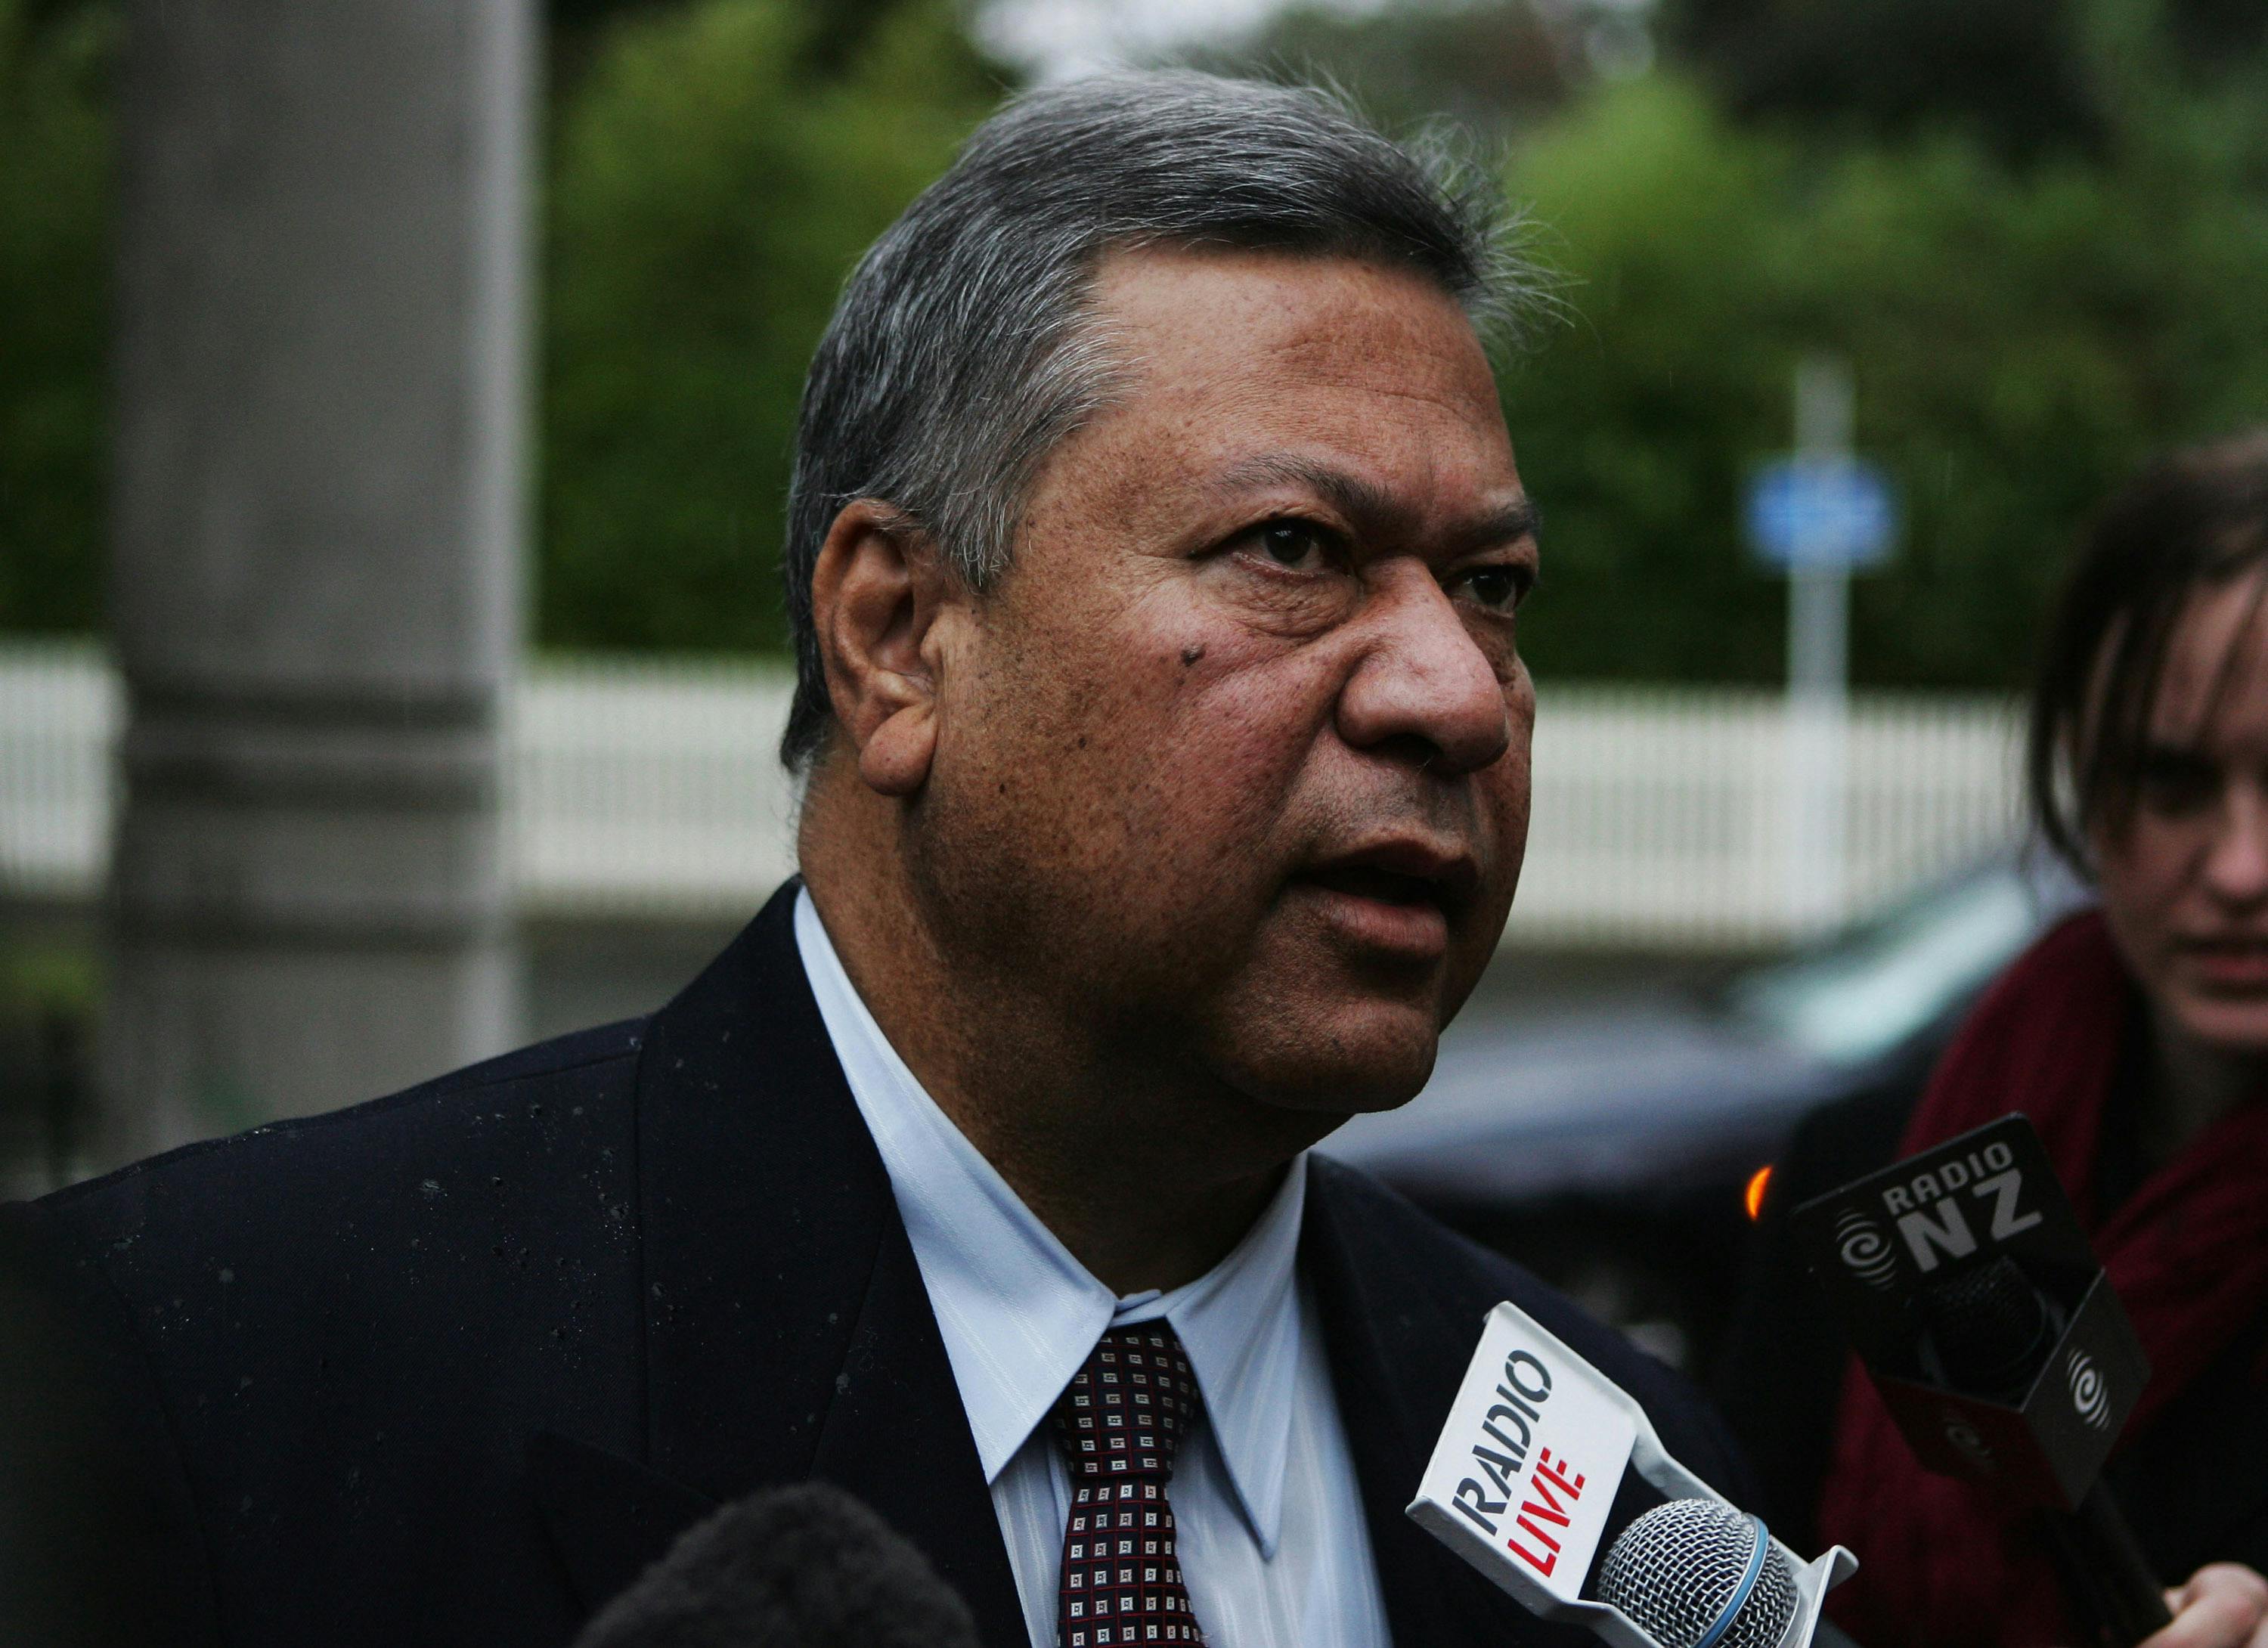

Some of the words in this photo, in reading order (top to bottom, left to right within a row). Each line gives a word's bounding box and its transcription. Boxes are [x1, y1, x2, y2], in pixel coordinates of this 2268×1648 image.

[1882, 1142, 2012, 1214] RADIO
[1898, 1169, 2042, 1272] NZ
[1452, 1349, 1552, 1536] RADIO
[1507, 1447, 1585, 1578] LIVE
